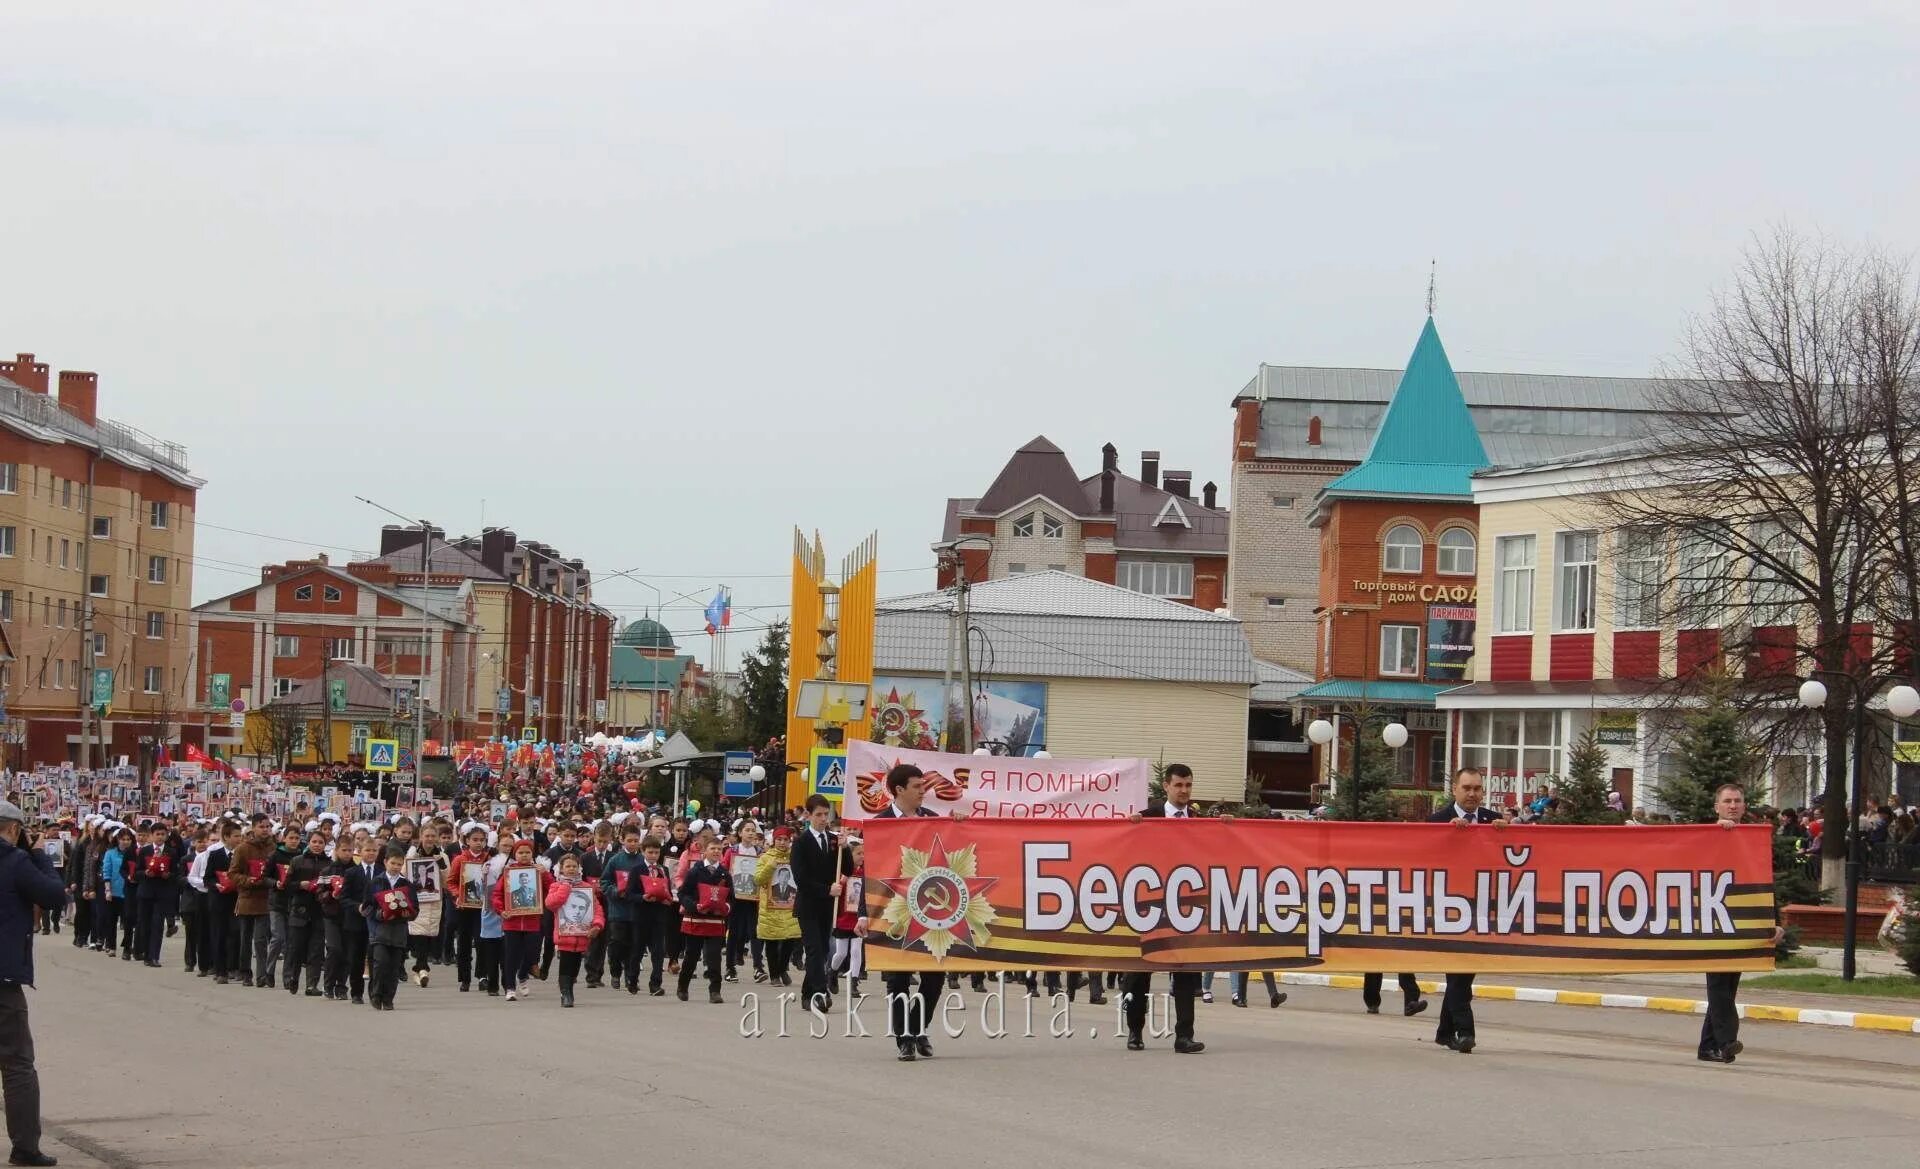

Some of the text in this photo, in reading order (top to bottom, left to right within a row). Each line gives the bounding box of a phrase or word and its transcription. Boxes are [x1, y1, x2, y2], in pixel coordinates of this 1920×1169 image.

[1353, 580, 1416, 592] Торговый
[1388, 592, 1416, 603] дом
[1432, 607, 1476, 620] ПАРИКМАХ
[979, 770, 1121, 793] Я ПОМНЮ!
[971, 800, 1135, 819] Я ГОРЖУСЬ!
[1023, 841, 1537, 957] Бессмертный
